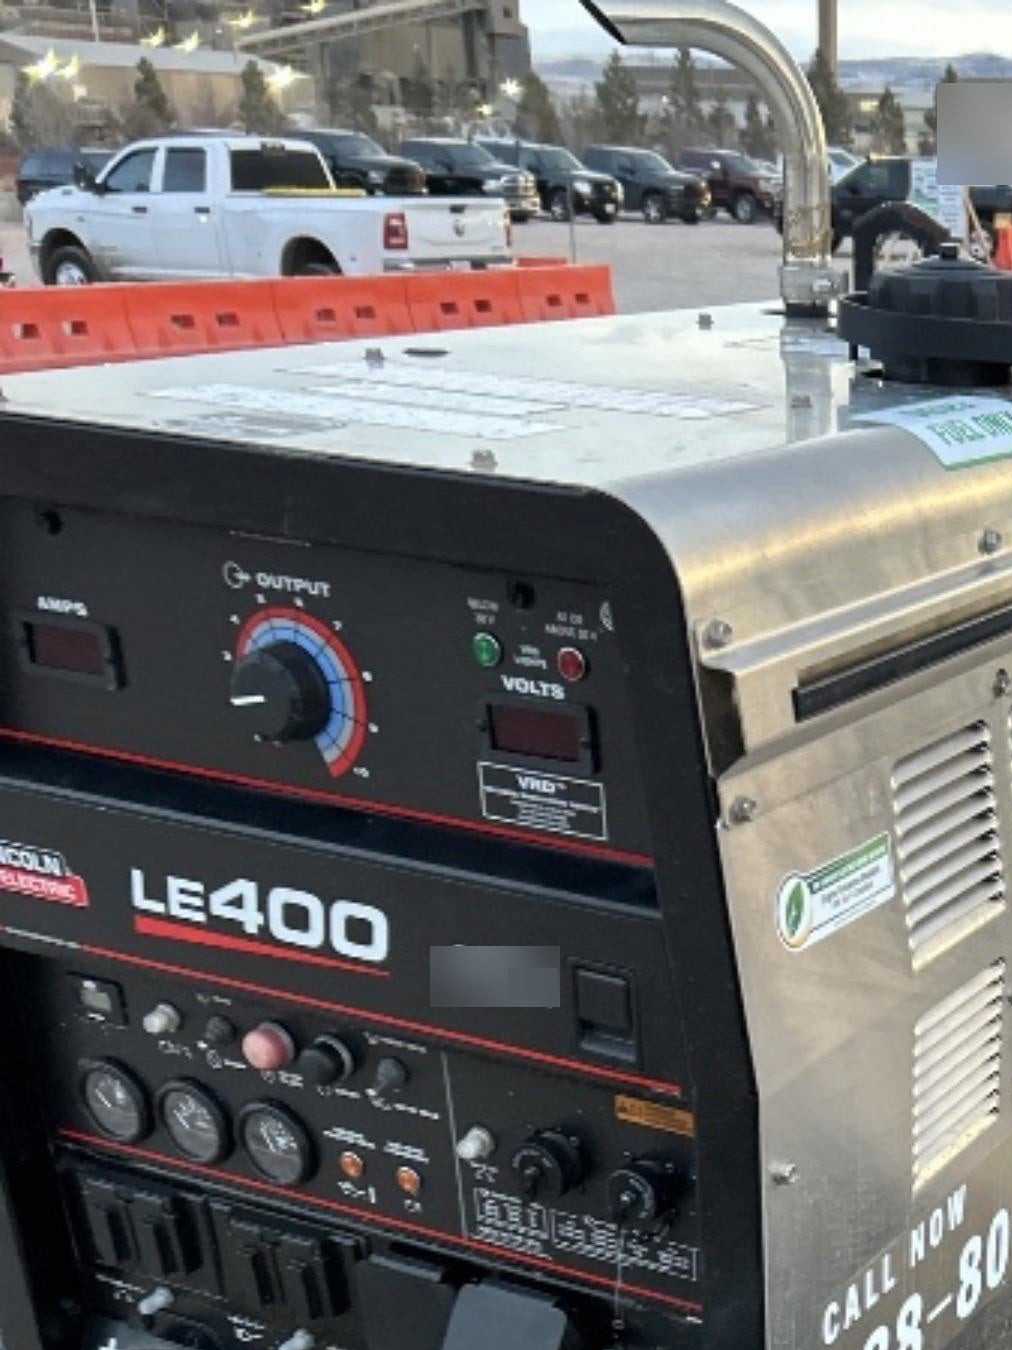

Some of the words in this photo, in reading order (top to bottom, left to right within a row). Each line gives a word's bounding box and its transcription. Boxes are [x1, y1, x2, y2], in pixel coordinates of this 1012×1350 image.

[256, 572, 331, 598] OUTPUT
[500, 674, 566, 700] VOLTS
[130, 866, 389, 962] LE400
[821, 1253, 896, 1346] CALL
[910, 1184, 968, 1268] NOW
